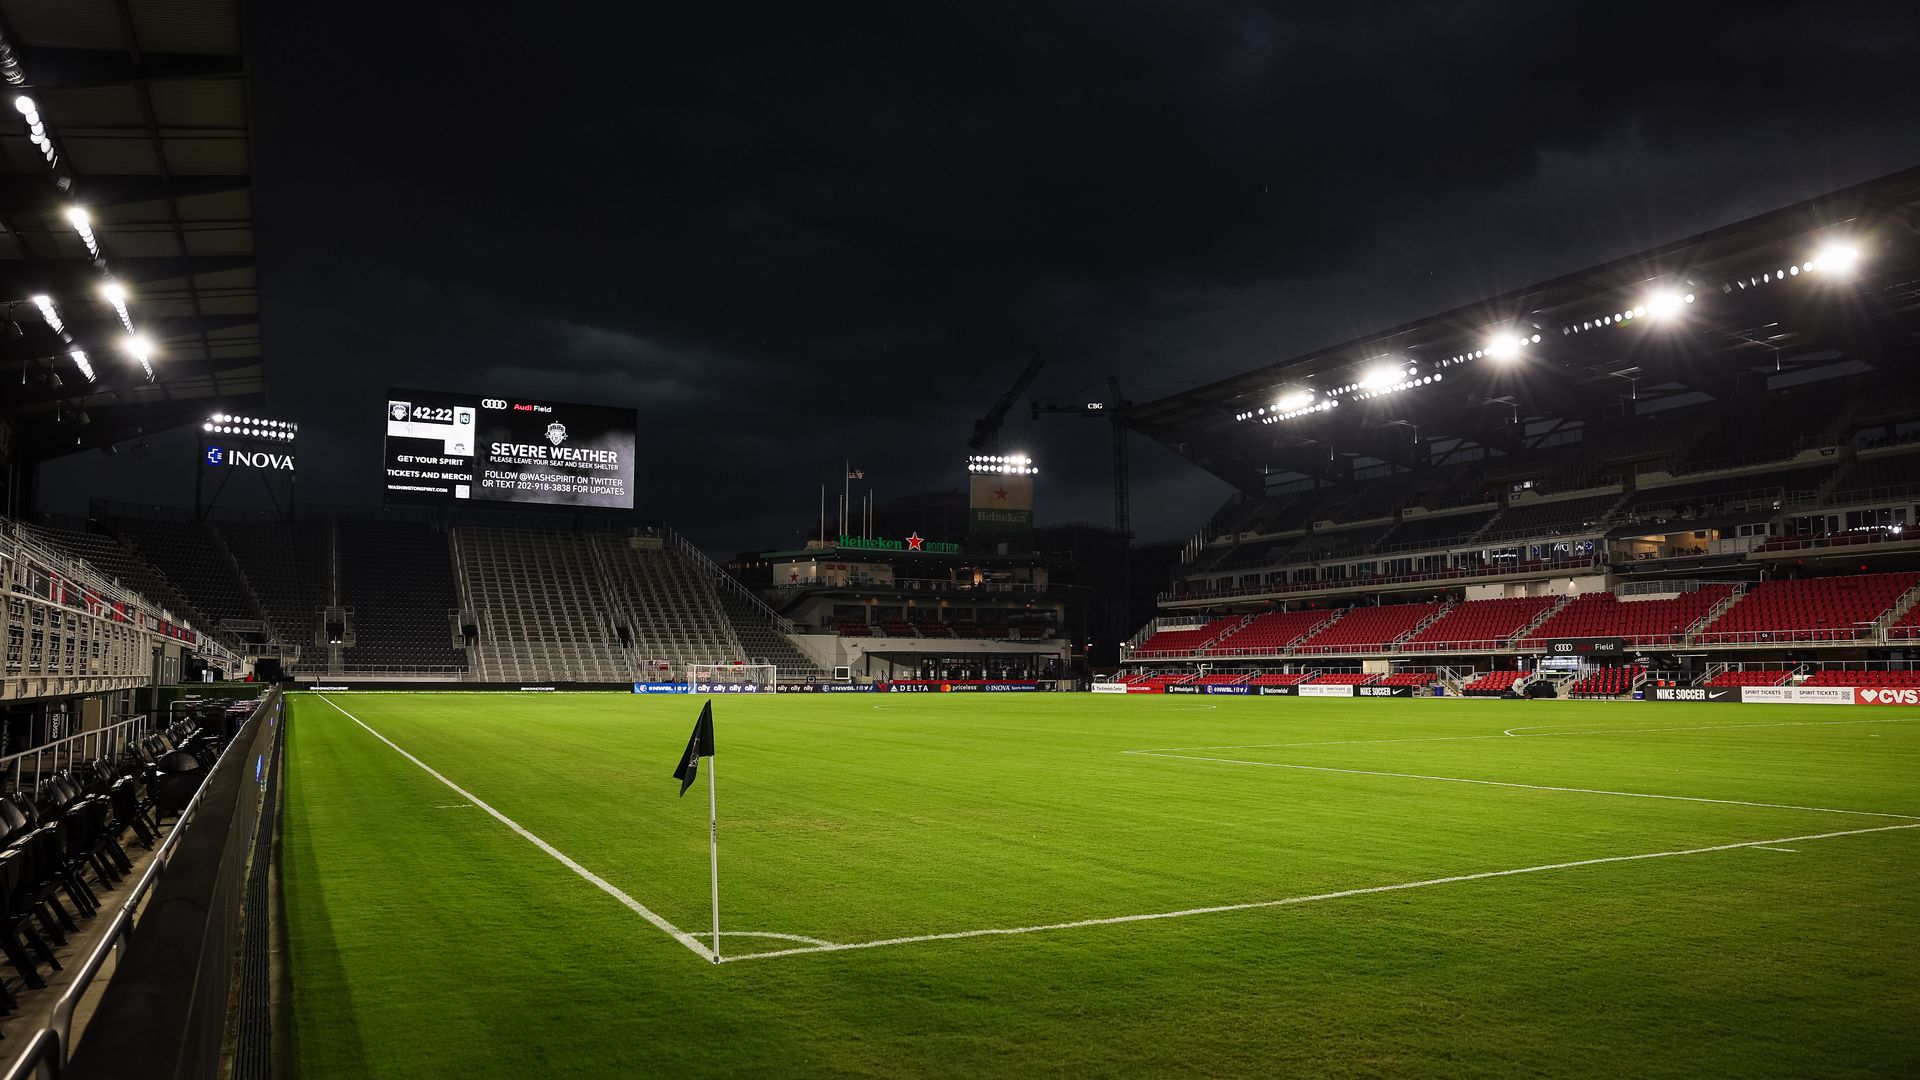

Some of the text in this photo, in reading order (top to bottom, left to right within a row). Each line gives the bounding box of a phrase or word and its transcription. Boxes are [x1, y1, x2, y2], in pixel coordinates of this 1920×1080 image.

[412, 406, 453, 422] 42:22
[534, 405, 552, 413] Field
[491, 442, 618, 463] SEVERE WEATHER
[229, 450, 295, 470] INOVA
[397, 455, 464, 466] GET YOUR SPIRIT
[490, 456, 513, 464] PLEASE
[514, 457, 532, 465] LEAVE
[593, 463, 619, 471] SHELTER
[387, 469, 420, 478] TICKETS
[421, 471, 440, 479] AND
[485, 470, 623, 487] FOLLOW @WASHSPIRIT ON TWITTER
[482, 479, 625, 496] OR TEXT 202-918-3838 FOR UPDATES
[977, 511, 1026, 523] Heineken
[839, 535, 902, 550] Heineken
[926, 542, 959, 553] ROOFTOP
[1594, 643, 1614, 651] Field
[697, 684, 757, 692] ally ally ally ally
[952, 684, 977, 692] priceless
[1360, 687, 1391, 696] NIKE SOCCER
[1656, 689, 1705, 700] NIKE SOCCER
[1879, 689, 1918, 704] CVS
